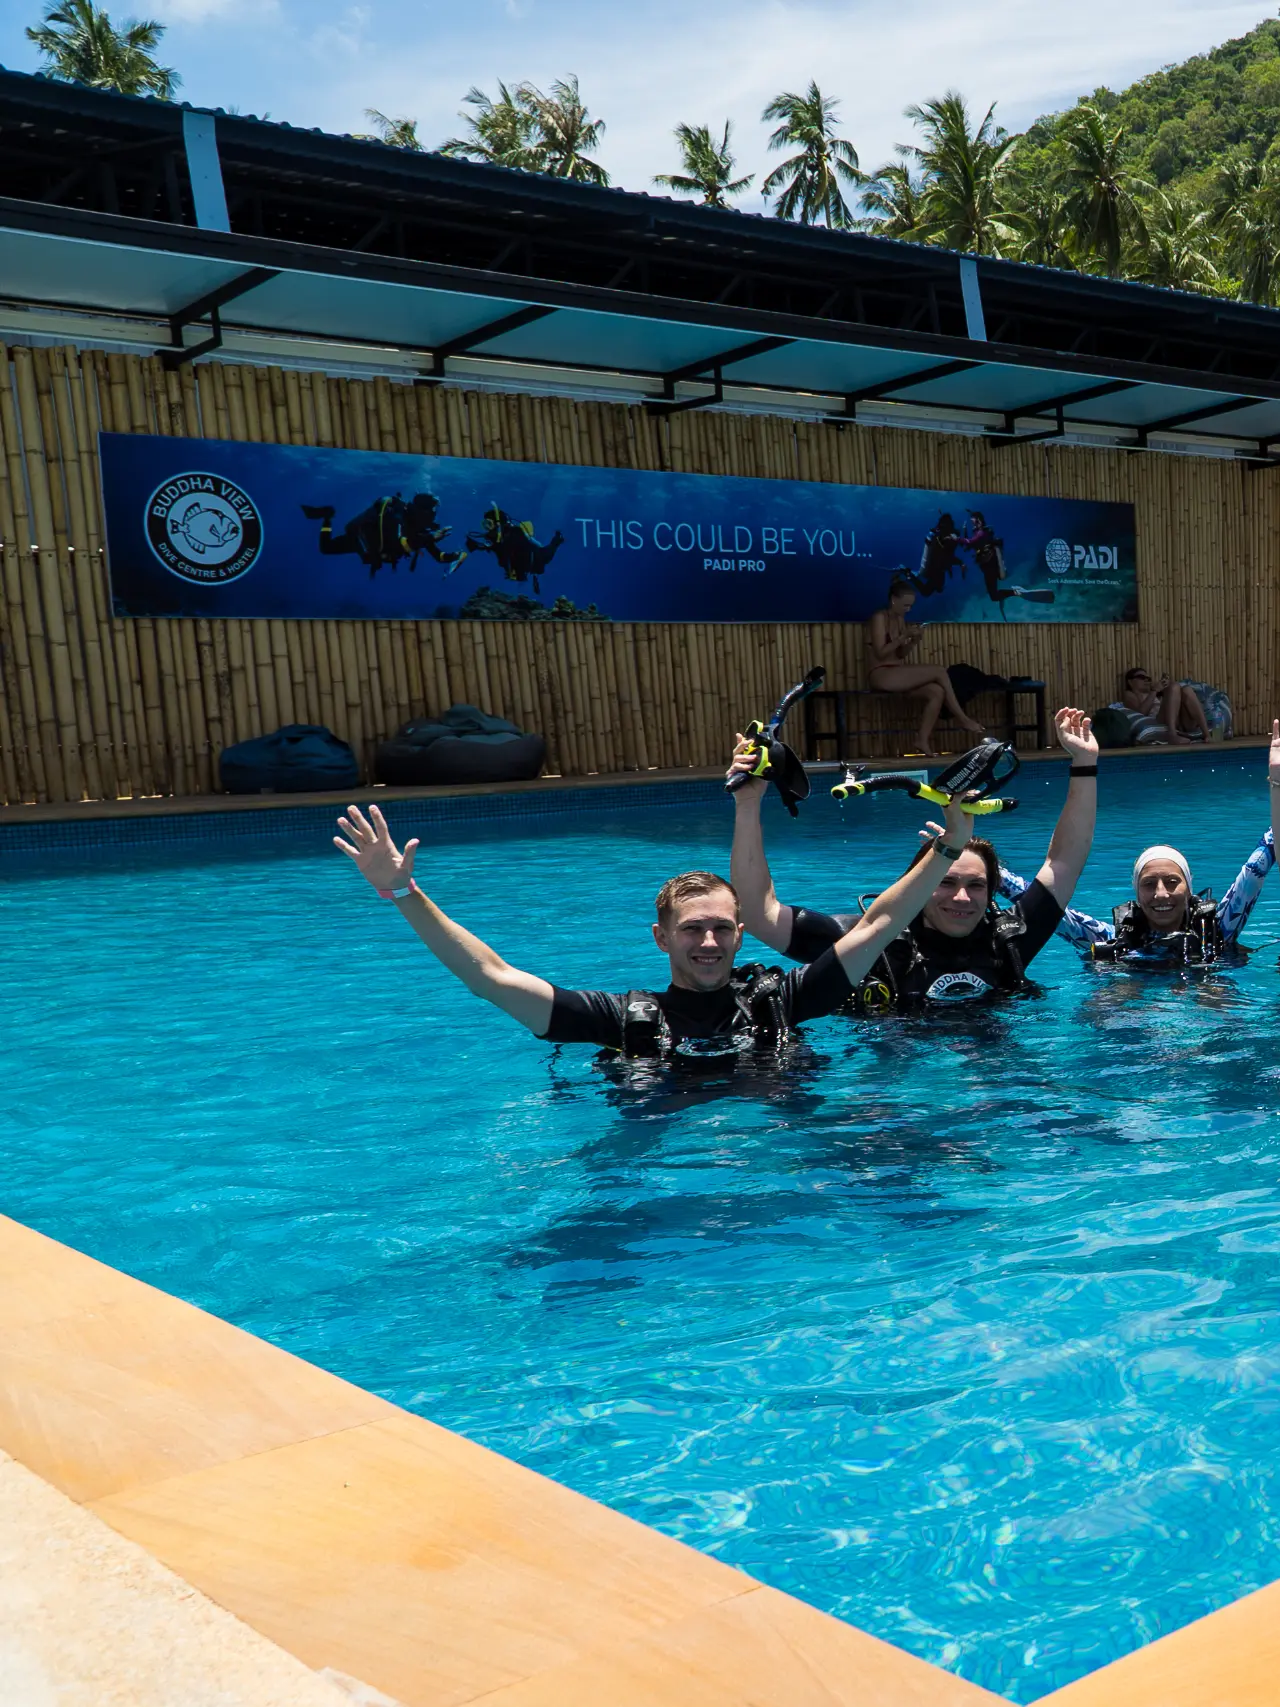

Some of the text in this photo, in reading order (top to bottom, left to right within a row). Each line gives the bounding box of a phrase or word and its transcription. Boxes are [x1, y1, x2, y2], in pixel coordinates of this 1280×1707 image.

[152, 476, 256, 521] BUDDHA VIEW
[575, 518, 873, 558] THIS COULD BE YOU...
[158, 542, 256, 578] DIVE CENTRE & HOSTEL
[703, 558, 766, 572] PADI PRO
[1073, 544, 1119, 570] PADI
[946, 767, 972, 790] BUDDHA
